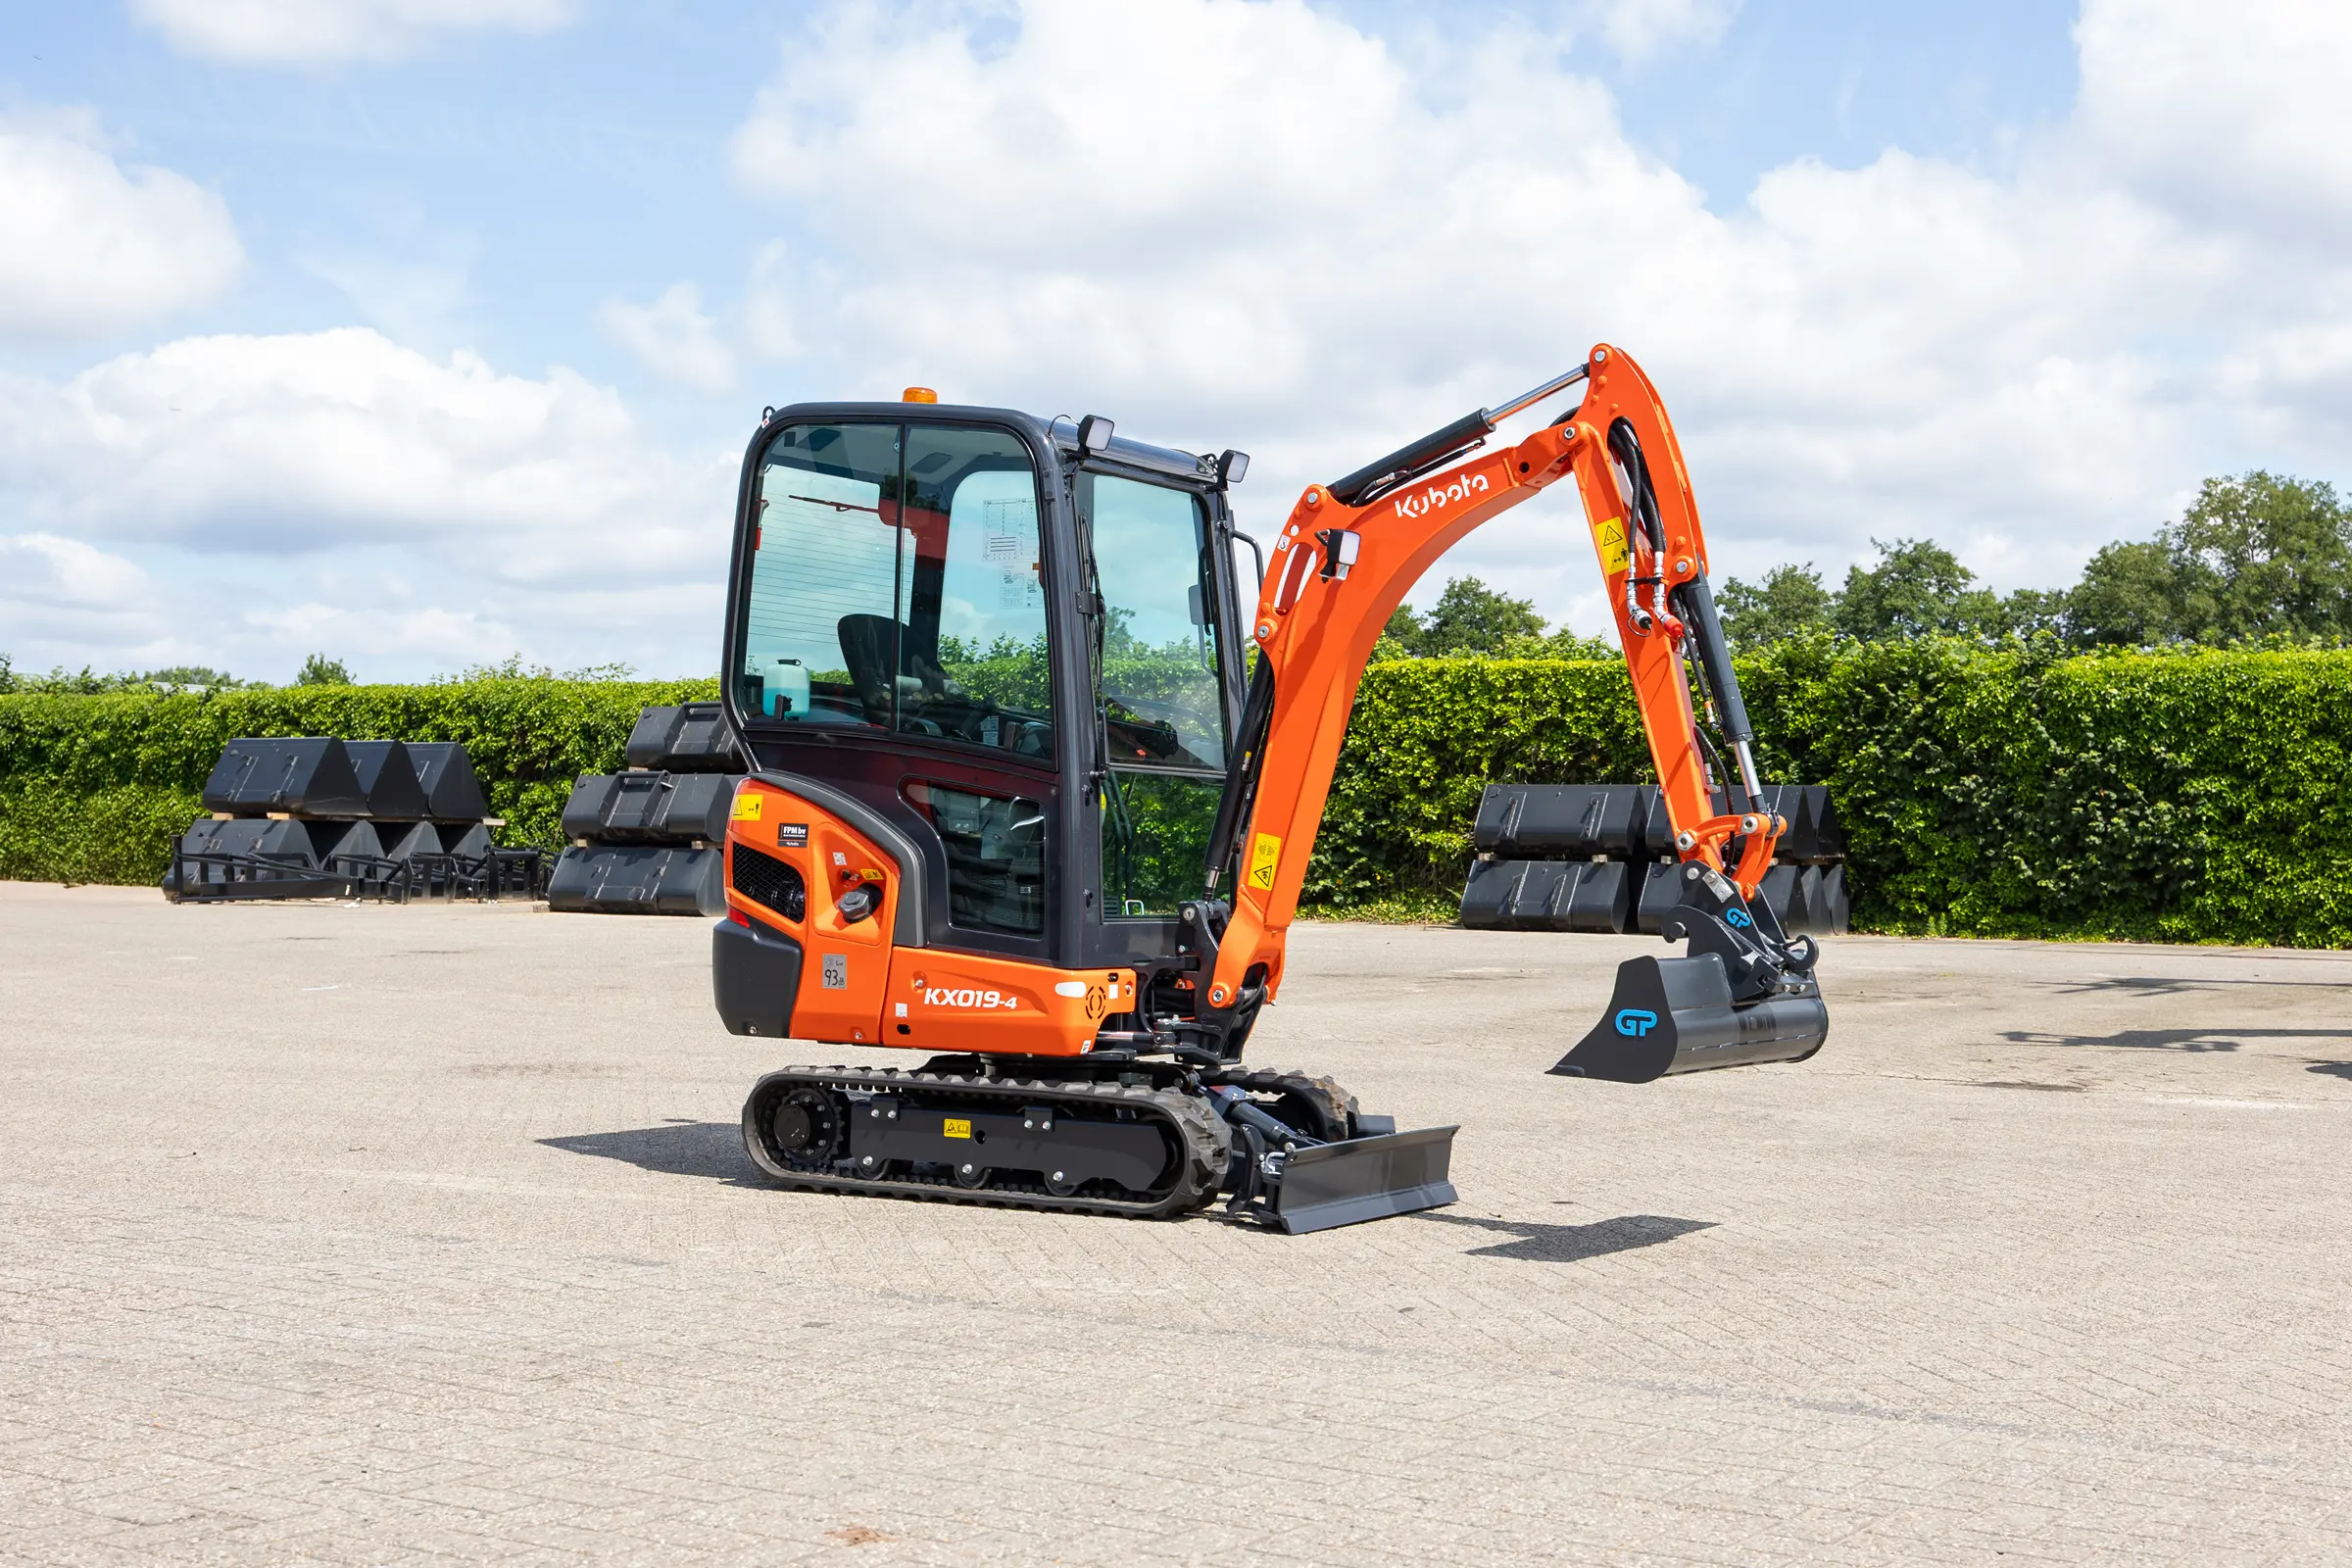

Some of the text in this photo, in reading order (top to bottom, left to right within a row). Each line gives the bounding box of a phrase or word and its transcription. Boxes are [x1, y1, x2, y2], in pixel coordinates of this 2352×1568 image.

[1395, 474, 1489, 518] Kubota
[1726, 907, 1751, 928] GP
[824, 969, 838, 986] 93
[924, 988, 1017, 1009] KX019-4
[1615, 1008, 1658, 1037] GP
